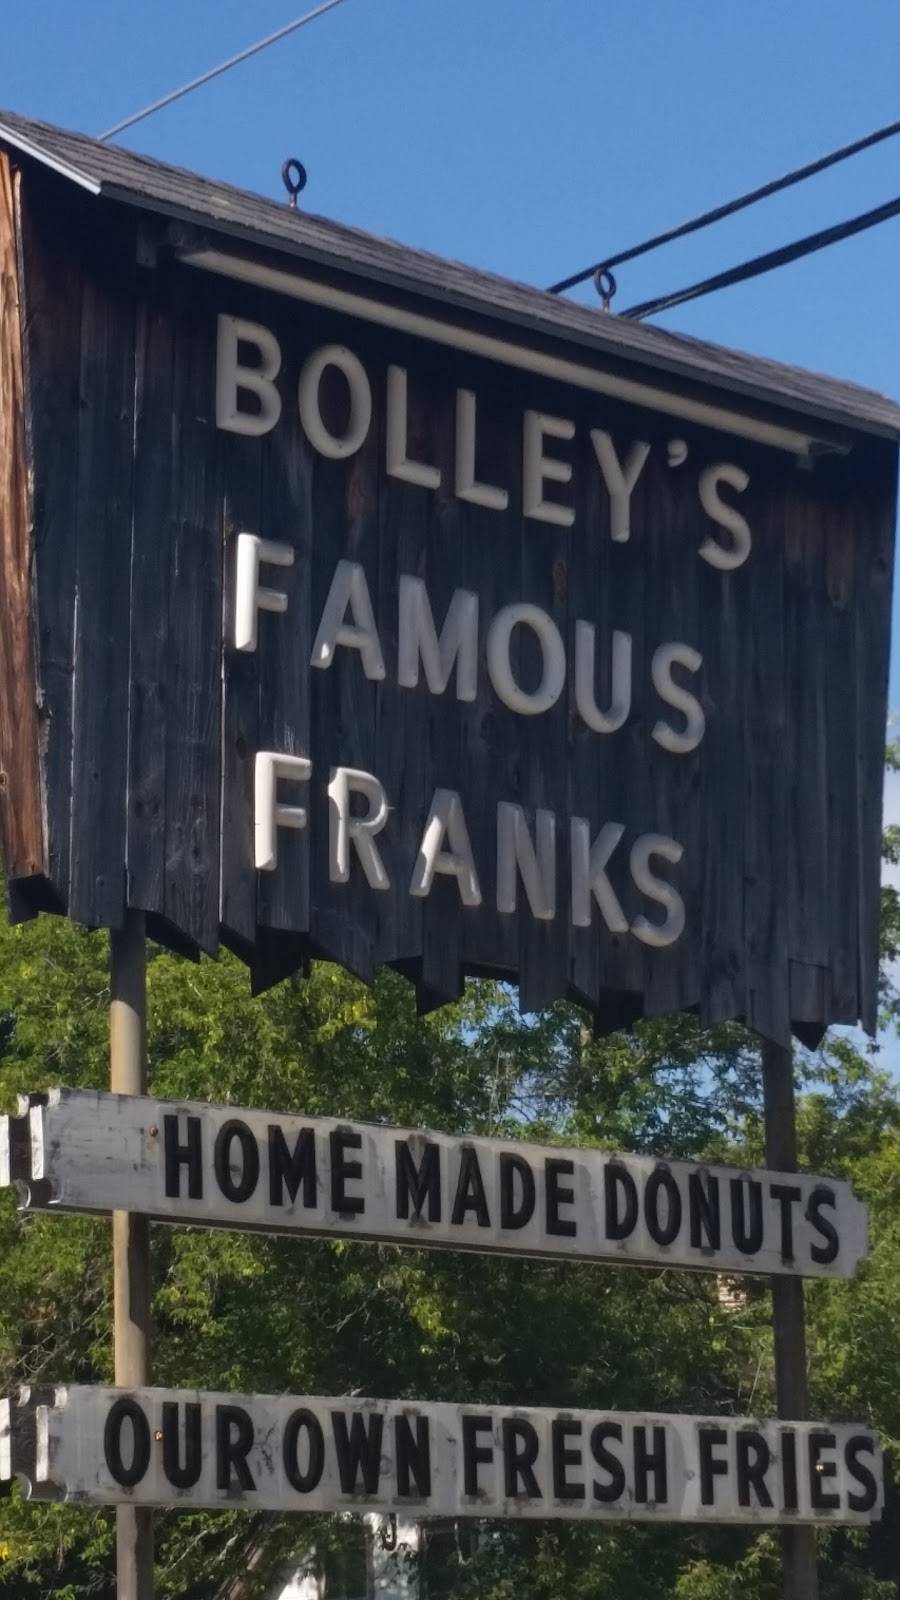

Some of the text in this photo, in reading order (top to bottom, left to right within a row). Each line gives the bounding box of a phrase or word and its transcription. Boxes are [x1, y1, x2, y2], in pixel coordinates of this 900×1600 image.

[216, 313, 752, 570] BOLLEY'S
[235, 533, 705, 754] FAMOUS
[254, 751, 685, 947] FRANKS
[164, 1114, 840, 1264] HOME MADE DONUTS
[103, 1399, 877, 1512] OUR OWN FRESH FRIES
